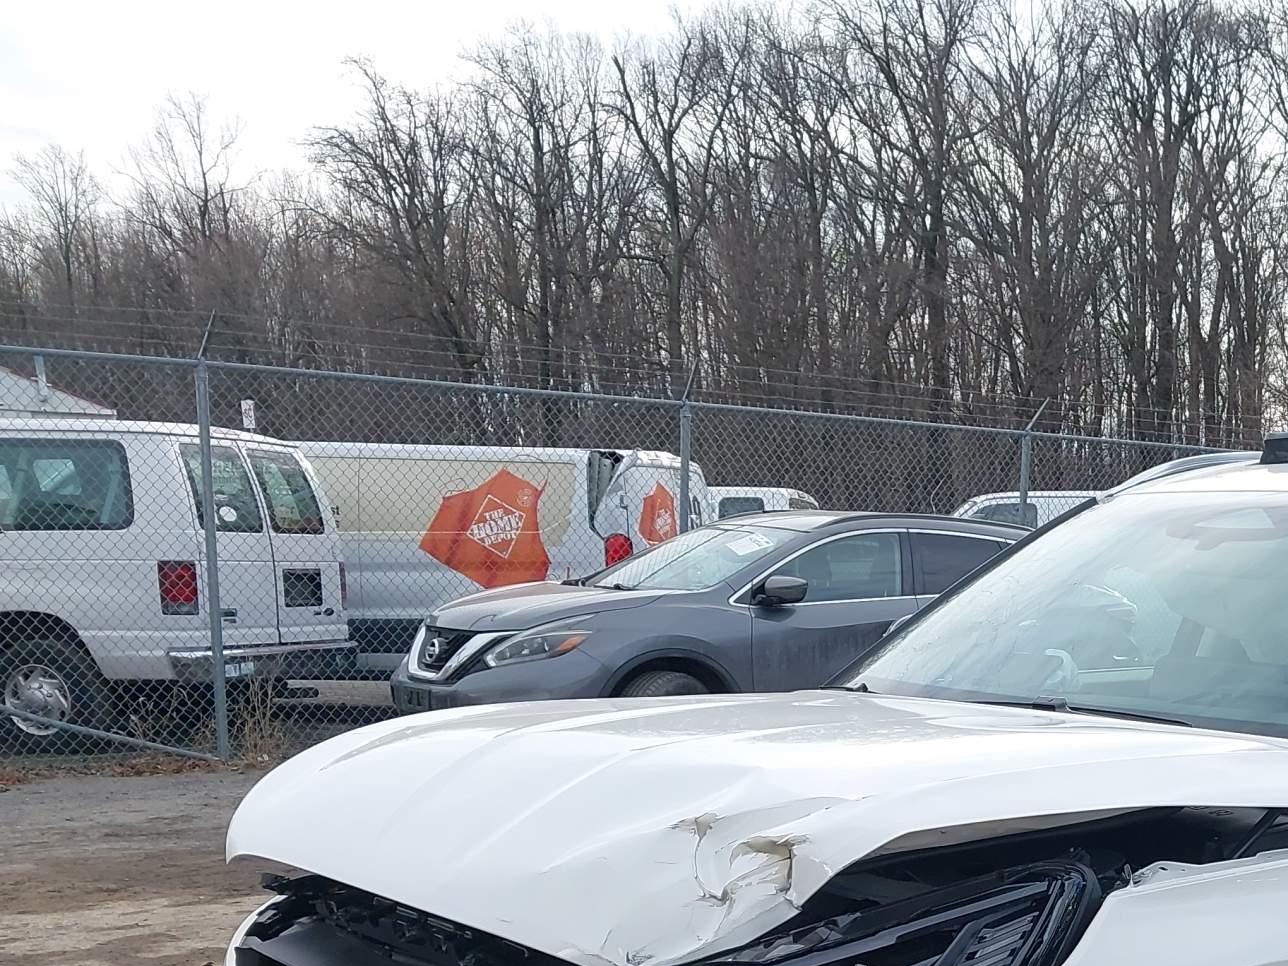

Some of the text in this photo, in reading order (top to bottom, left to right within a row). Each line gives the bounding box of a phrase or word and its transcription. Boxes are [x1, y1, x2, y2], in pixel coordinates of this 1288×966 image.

[484, 508, 504, 521] THE
[470, 512, 521, 540] HOME
[484, 530, 517, 545] DEPOT
